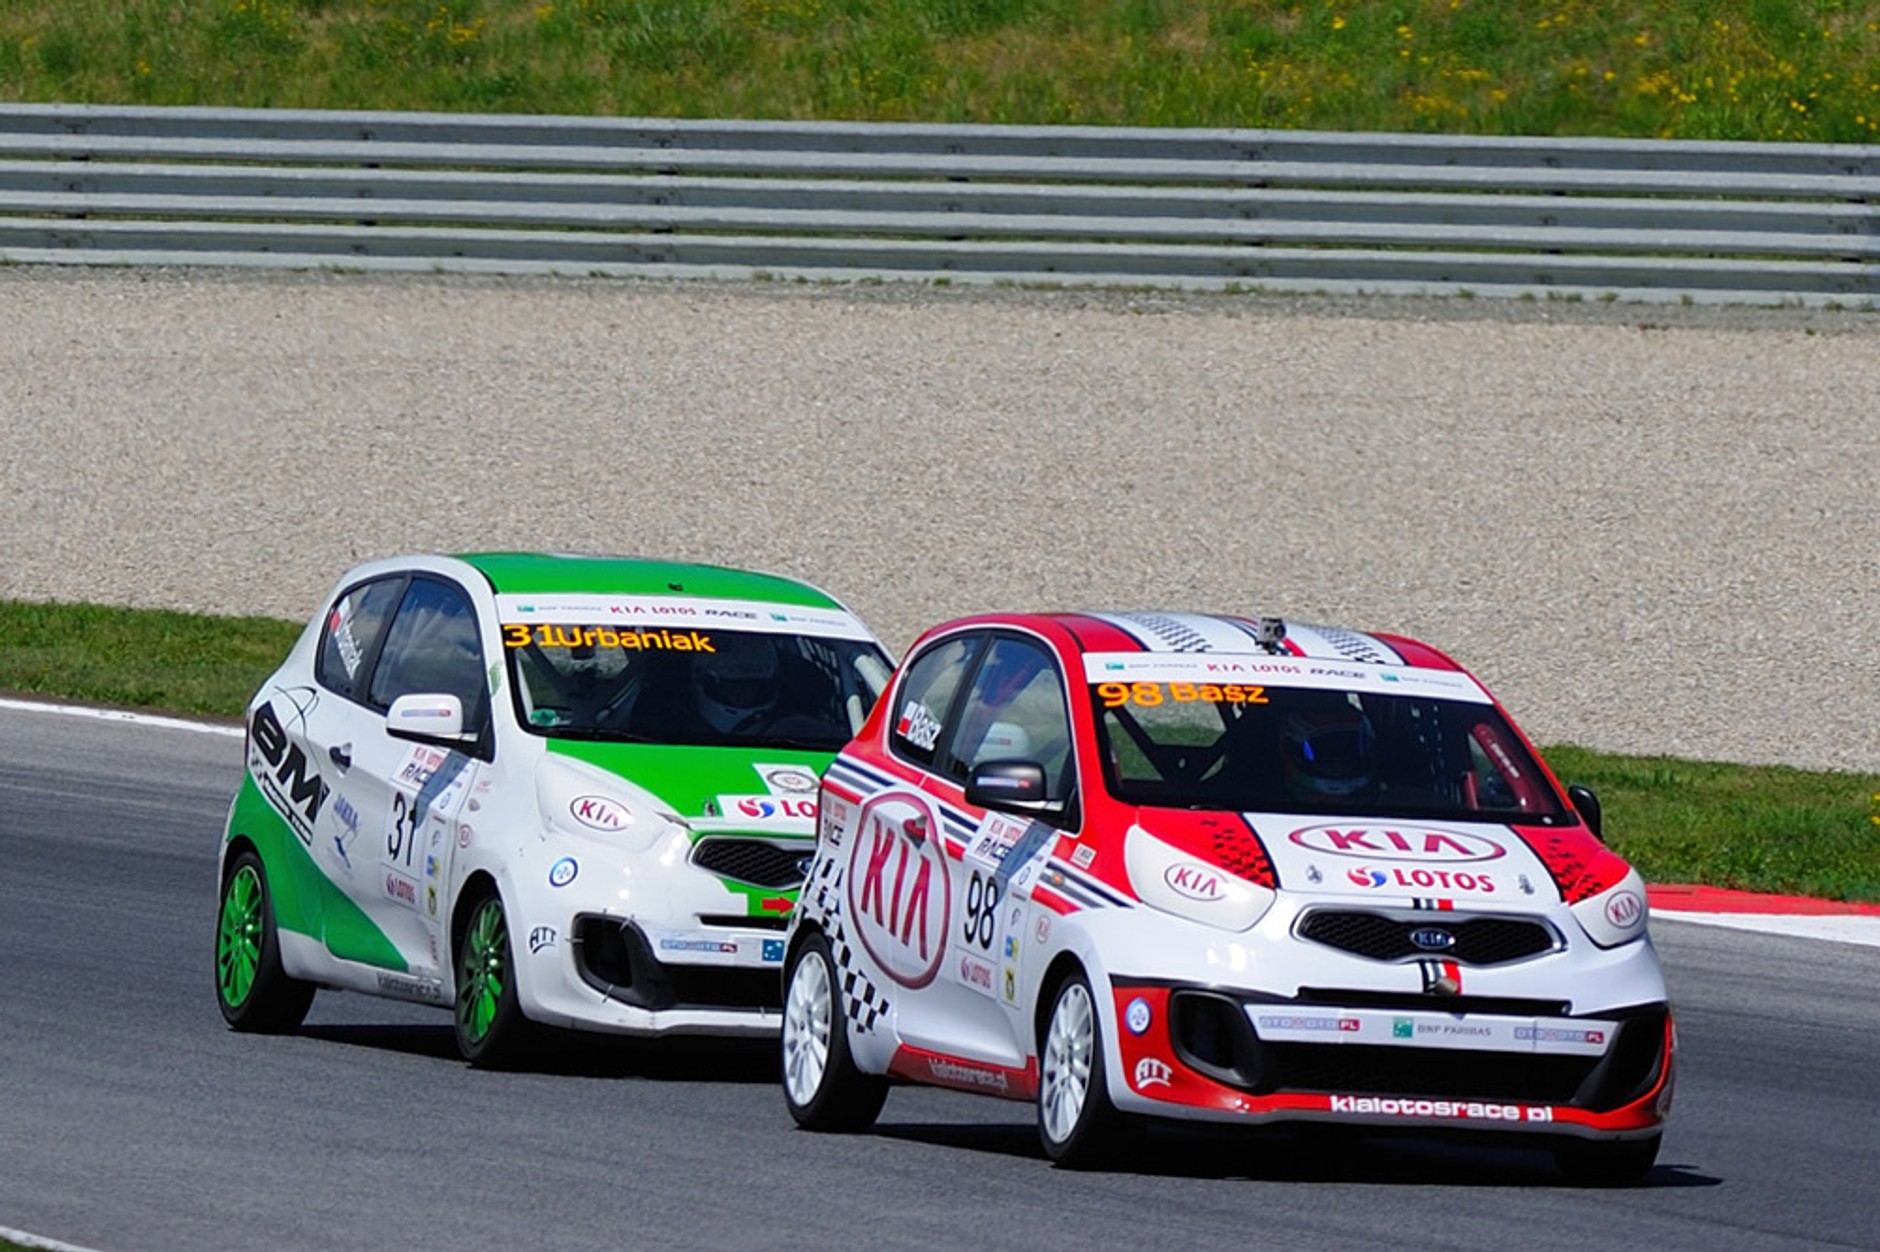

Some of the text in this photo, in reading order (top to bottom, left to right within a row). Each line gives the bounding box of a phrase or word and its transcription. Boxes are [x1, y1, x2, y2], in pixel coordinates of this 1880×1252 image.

[1098, 682, 1270, 708] 98 Basz
[579, 799, 619, 828] KIA
[388, 791, 417, 867] 31
[1324, 829, 1478, 857] KIA
[861, 815, 929, 962] KIA
[1173, 867, 1218, 896] KIA
[1392, 868, 1496, 893] LOTOS
[964, 869, 998, 951] 98
[1610, 897, 1640, 923] KIA
